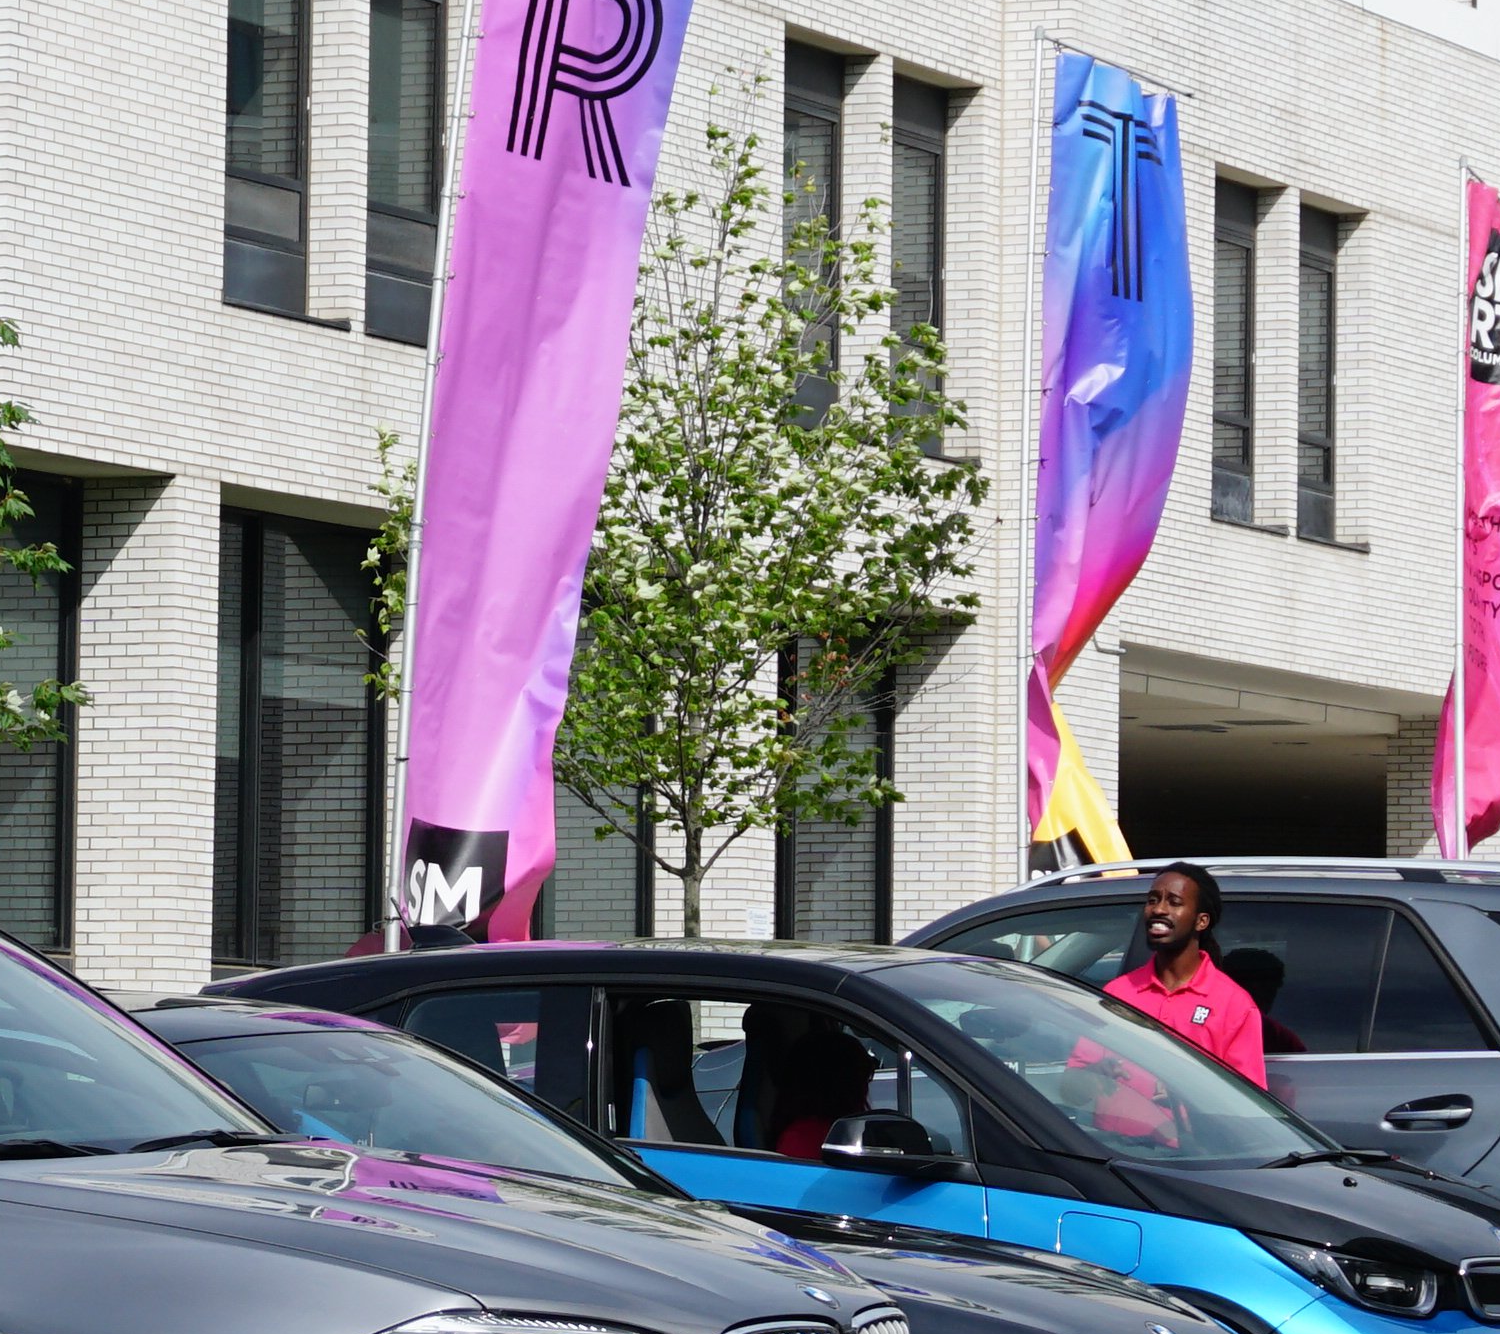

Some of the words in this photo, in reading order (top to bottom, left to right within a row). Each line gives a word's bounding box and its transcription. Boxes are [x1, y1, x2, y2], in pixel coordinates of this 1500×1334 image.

[1078, 100, 1164, 302] T
[408, 858, 483, 926] SM
[1004, 1061, 1019, 1075] M
